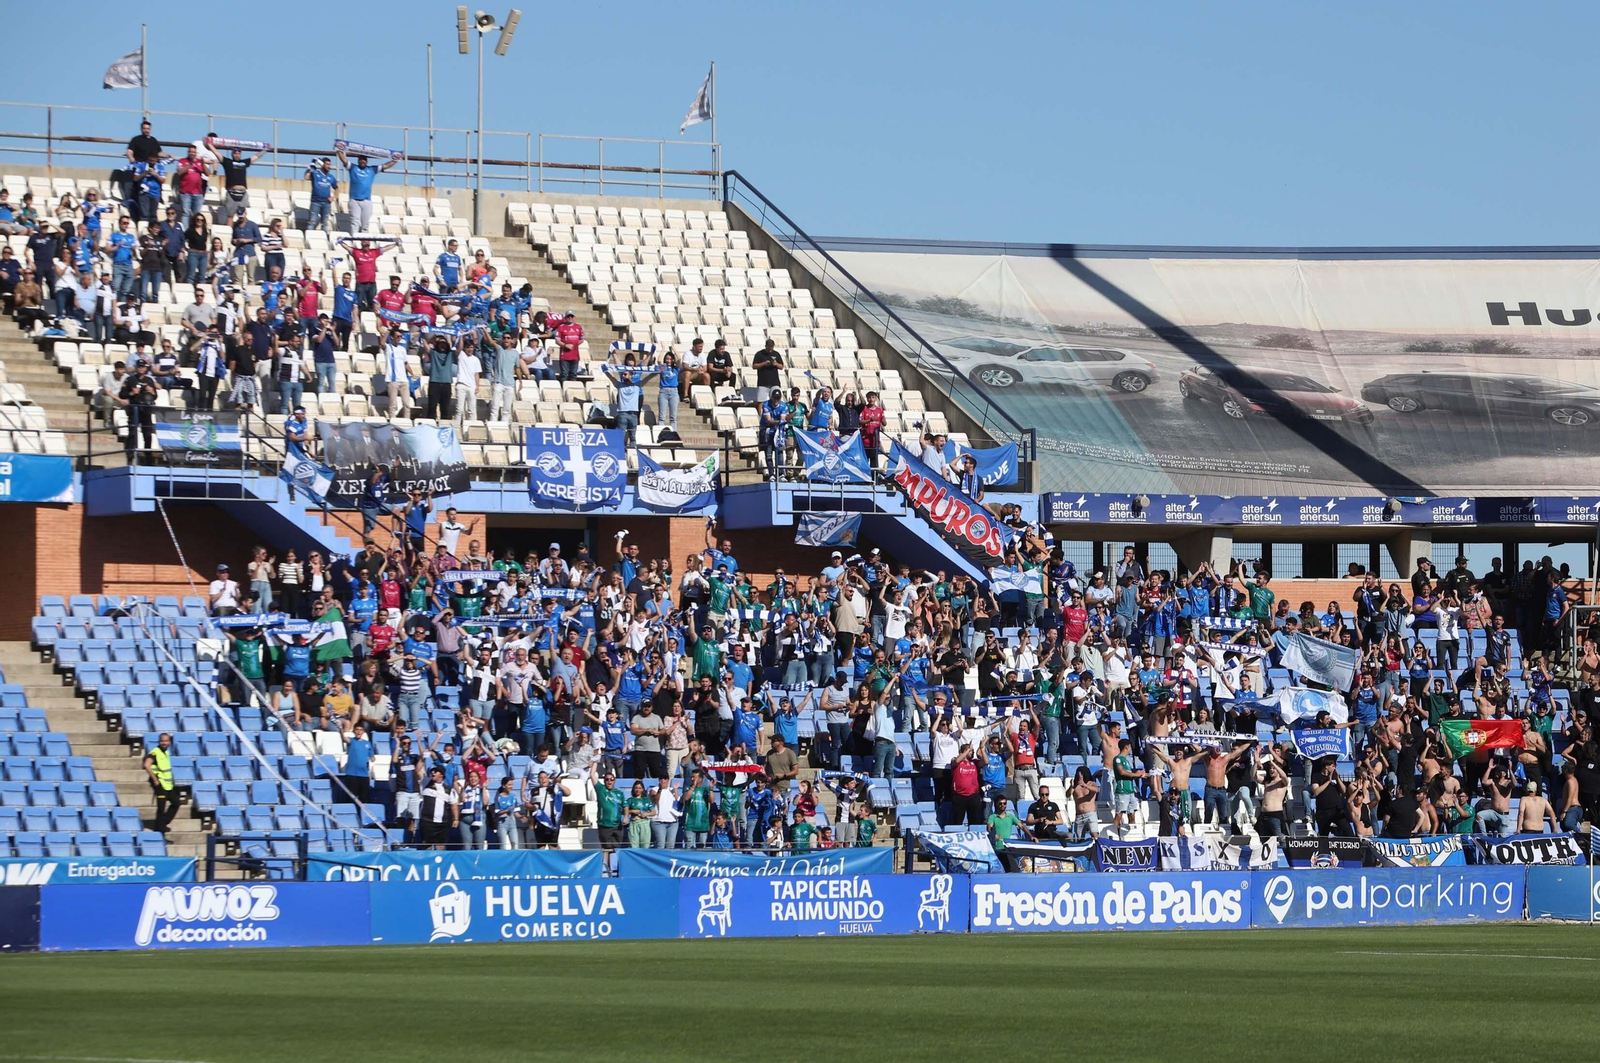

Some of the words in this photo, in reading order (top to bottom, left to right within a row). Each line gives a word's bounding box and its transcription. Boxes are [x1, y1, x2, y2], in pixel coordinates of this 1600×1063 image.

[1486, 302, 1600, 326] Hu
[542, 431, 608, 446] FUERZA
[536, 481, 621, 501] XERECISTA
[894, 463, 1001, 557] MPUROS
[1052, 501, 1073, 510] alter
[1109, 502, 1130, 511] alter
[1165, 503, 1186, 512] alter
[1242, 504, 1264, 514] alter
[1300, 504, 1322, 514] alter
[1363, 505, 1384, 514] alter
[1432, 506, 1455, 514] alter
[1500, 506, 1522, 514] alter
[1567, 505, 1590, 514] alter
[1053, 510, 1089, 518] enersun
[1166, 512, 1202, 520] enersun
[1242, 513, 1281, 521] enersun
[1300, 513, 1339, 521] enersun
[1567, 513, 1599, 521] eners
[542, 589, 565, 597] XEREZ
[957, 831, 987, 842] BOYS
[1161, 842, 1176, 858] K
[1193, 841, 1206, 857] S
[1218, 841, 1230, 860] X
[1328, 841, 1360, 849] INFIERNO
[1476, 836, 1576, 864] YOUTH
[1100, 844, 1155, 866] NEW
[68, 861, 155, 880] Entregados
[756, 859, 785, 876] del
[791, 857, 845, 876] Odiel
[771, 875, 873, 900] TAPICERÍA
[485, 883, 625, 917] HUELVA
[973, 882, 1099, 926] Fresón
[1102, 881, 1146, 924] de
[1150, 880, 1242, 923] Palos
[135, 885, 280, 946] MUÑOZ
[771, 900, 884, 921] RAIMUNDO
[157, 923, 267, 943] decoración
[501, 921, 612, 938] COMERCIO
[839, 923, 875, 933] HUELVA
